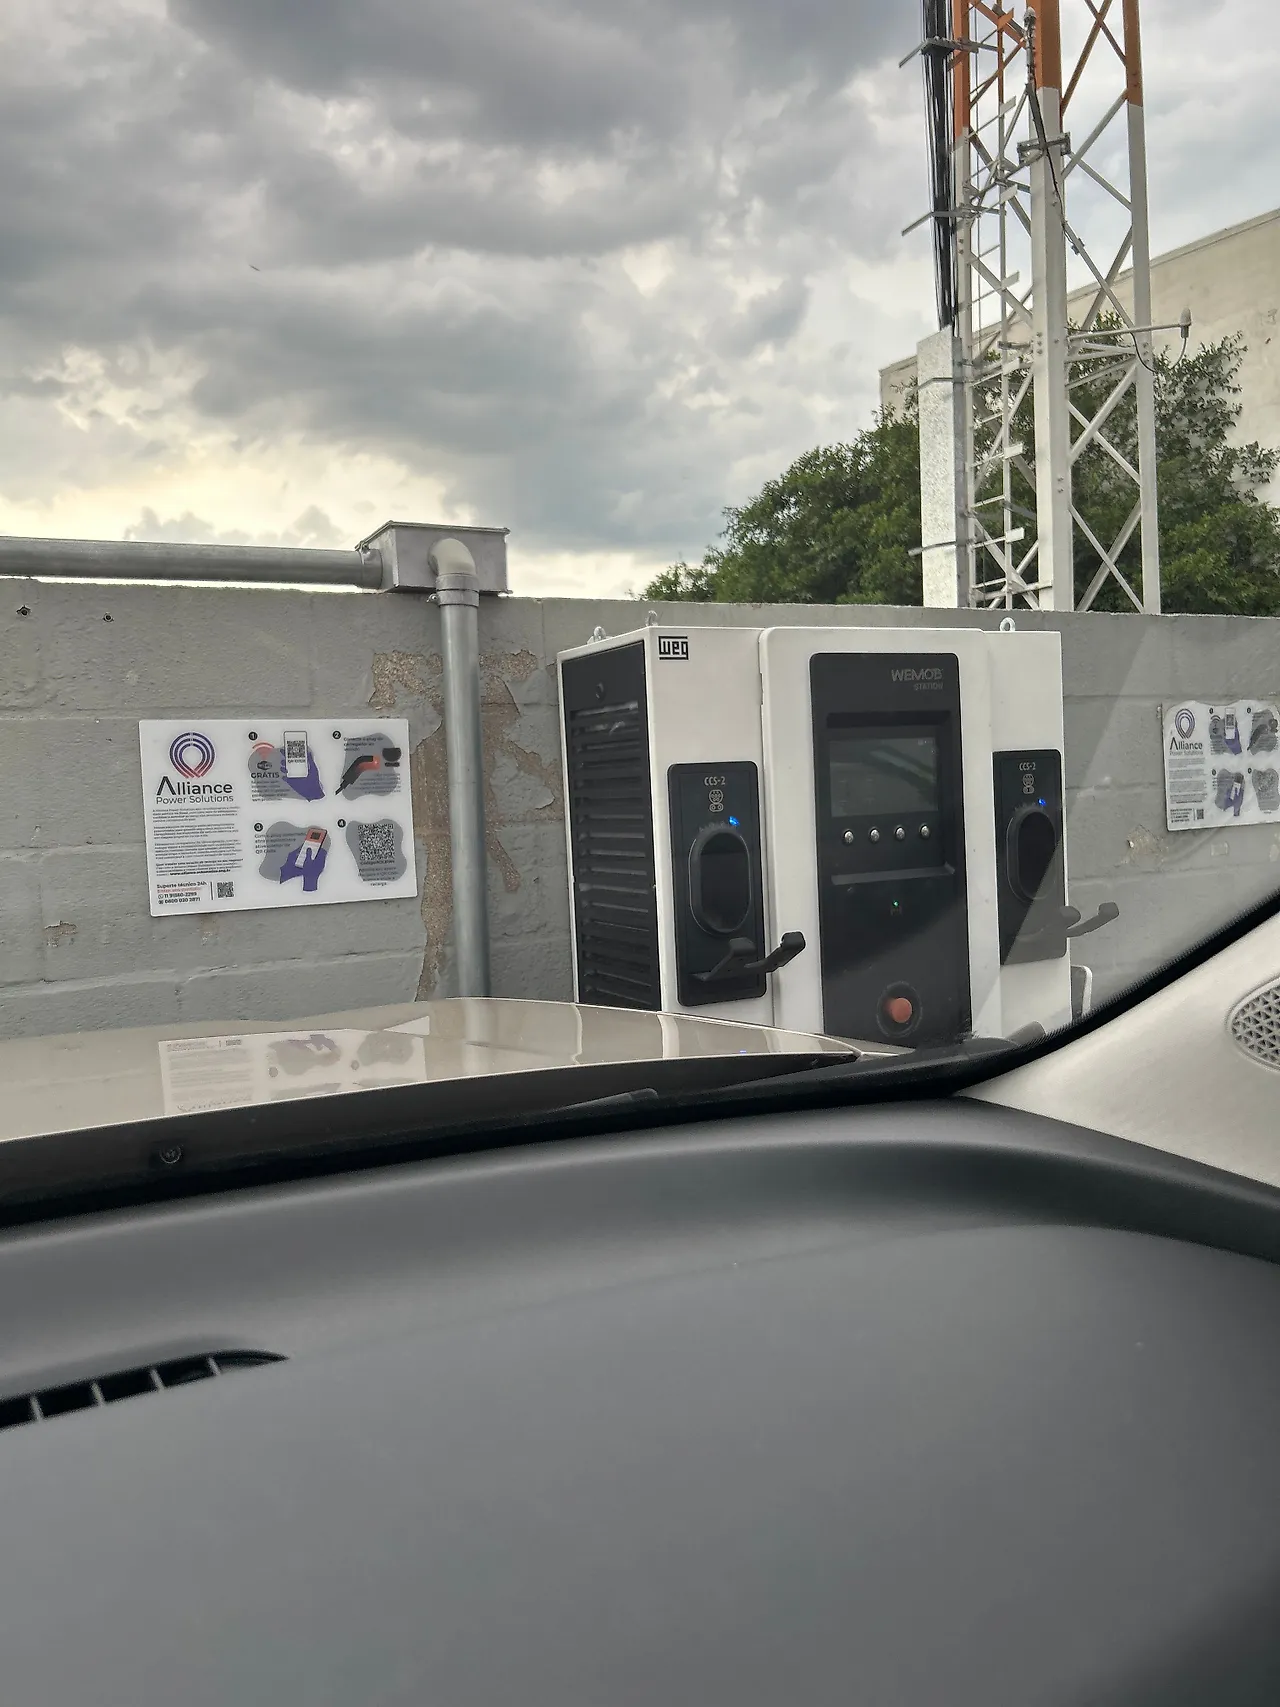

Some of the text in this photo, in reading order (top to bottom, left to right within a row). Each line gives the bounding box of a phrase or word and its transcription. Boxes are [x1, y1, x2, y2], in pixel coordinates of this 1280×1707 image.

[891, 668, 943, 682] WEMOB
[913, 682, 943, 691] STATION
[1170, 736, 1203, 751] Alliance
[1019, 762, 1036, 771] CCS-2
[156, 776, 233, 796] Alliance
[704, 776, 726, 786] CCS-2
[156, 795, 234, 804] Power Solutions
